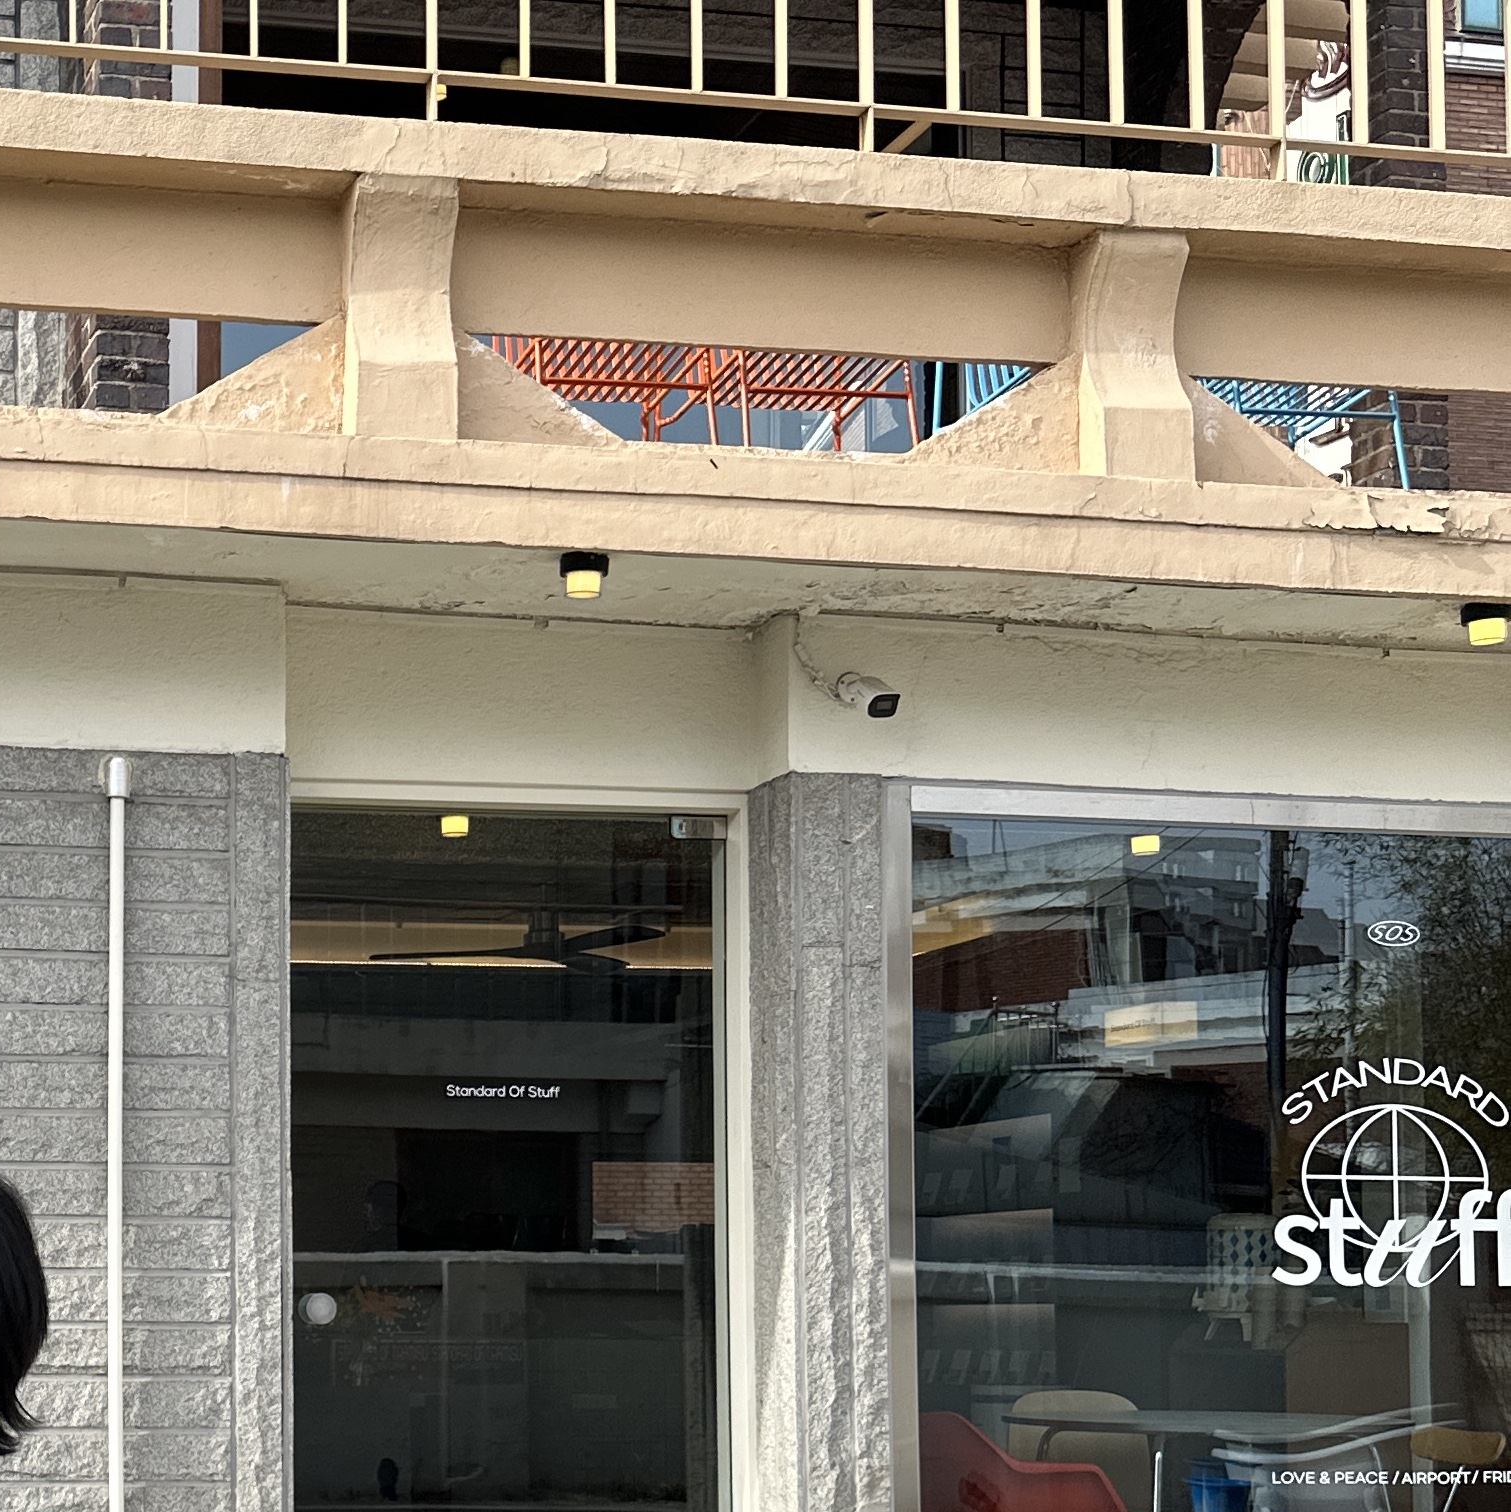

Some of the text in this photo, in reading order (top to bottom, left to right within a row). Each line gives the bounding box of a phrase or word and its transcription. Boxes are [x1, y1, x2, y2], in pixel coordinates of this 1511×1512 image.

[1373, 923, 1416, 943] SOS
[446, 1084, 561, 1098] Standard Of Stuff
[1281, 1057, 1510, 1128] STANDARD
[1271, 1471, 1316, 1485] LOVE
[1319, 1471, 1331, 1485] &
[1334, 1471, 1389, 1485] PEACE
